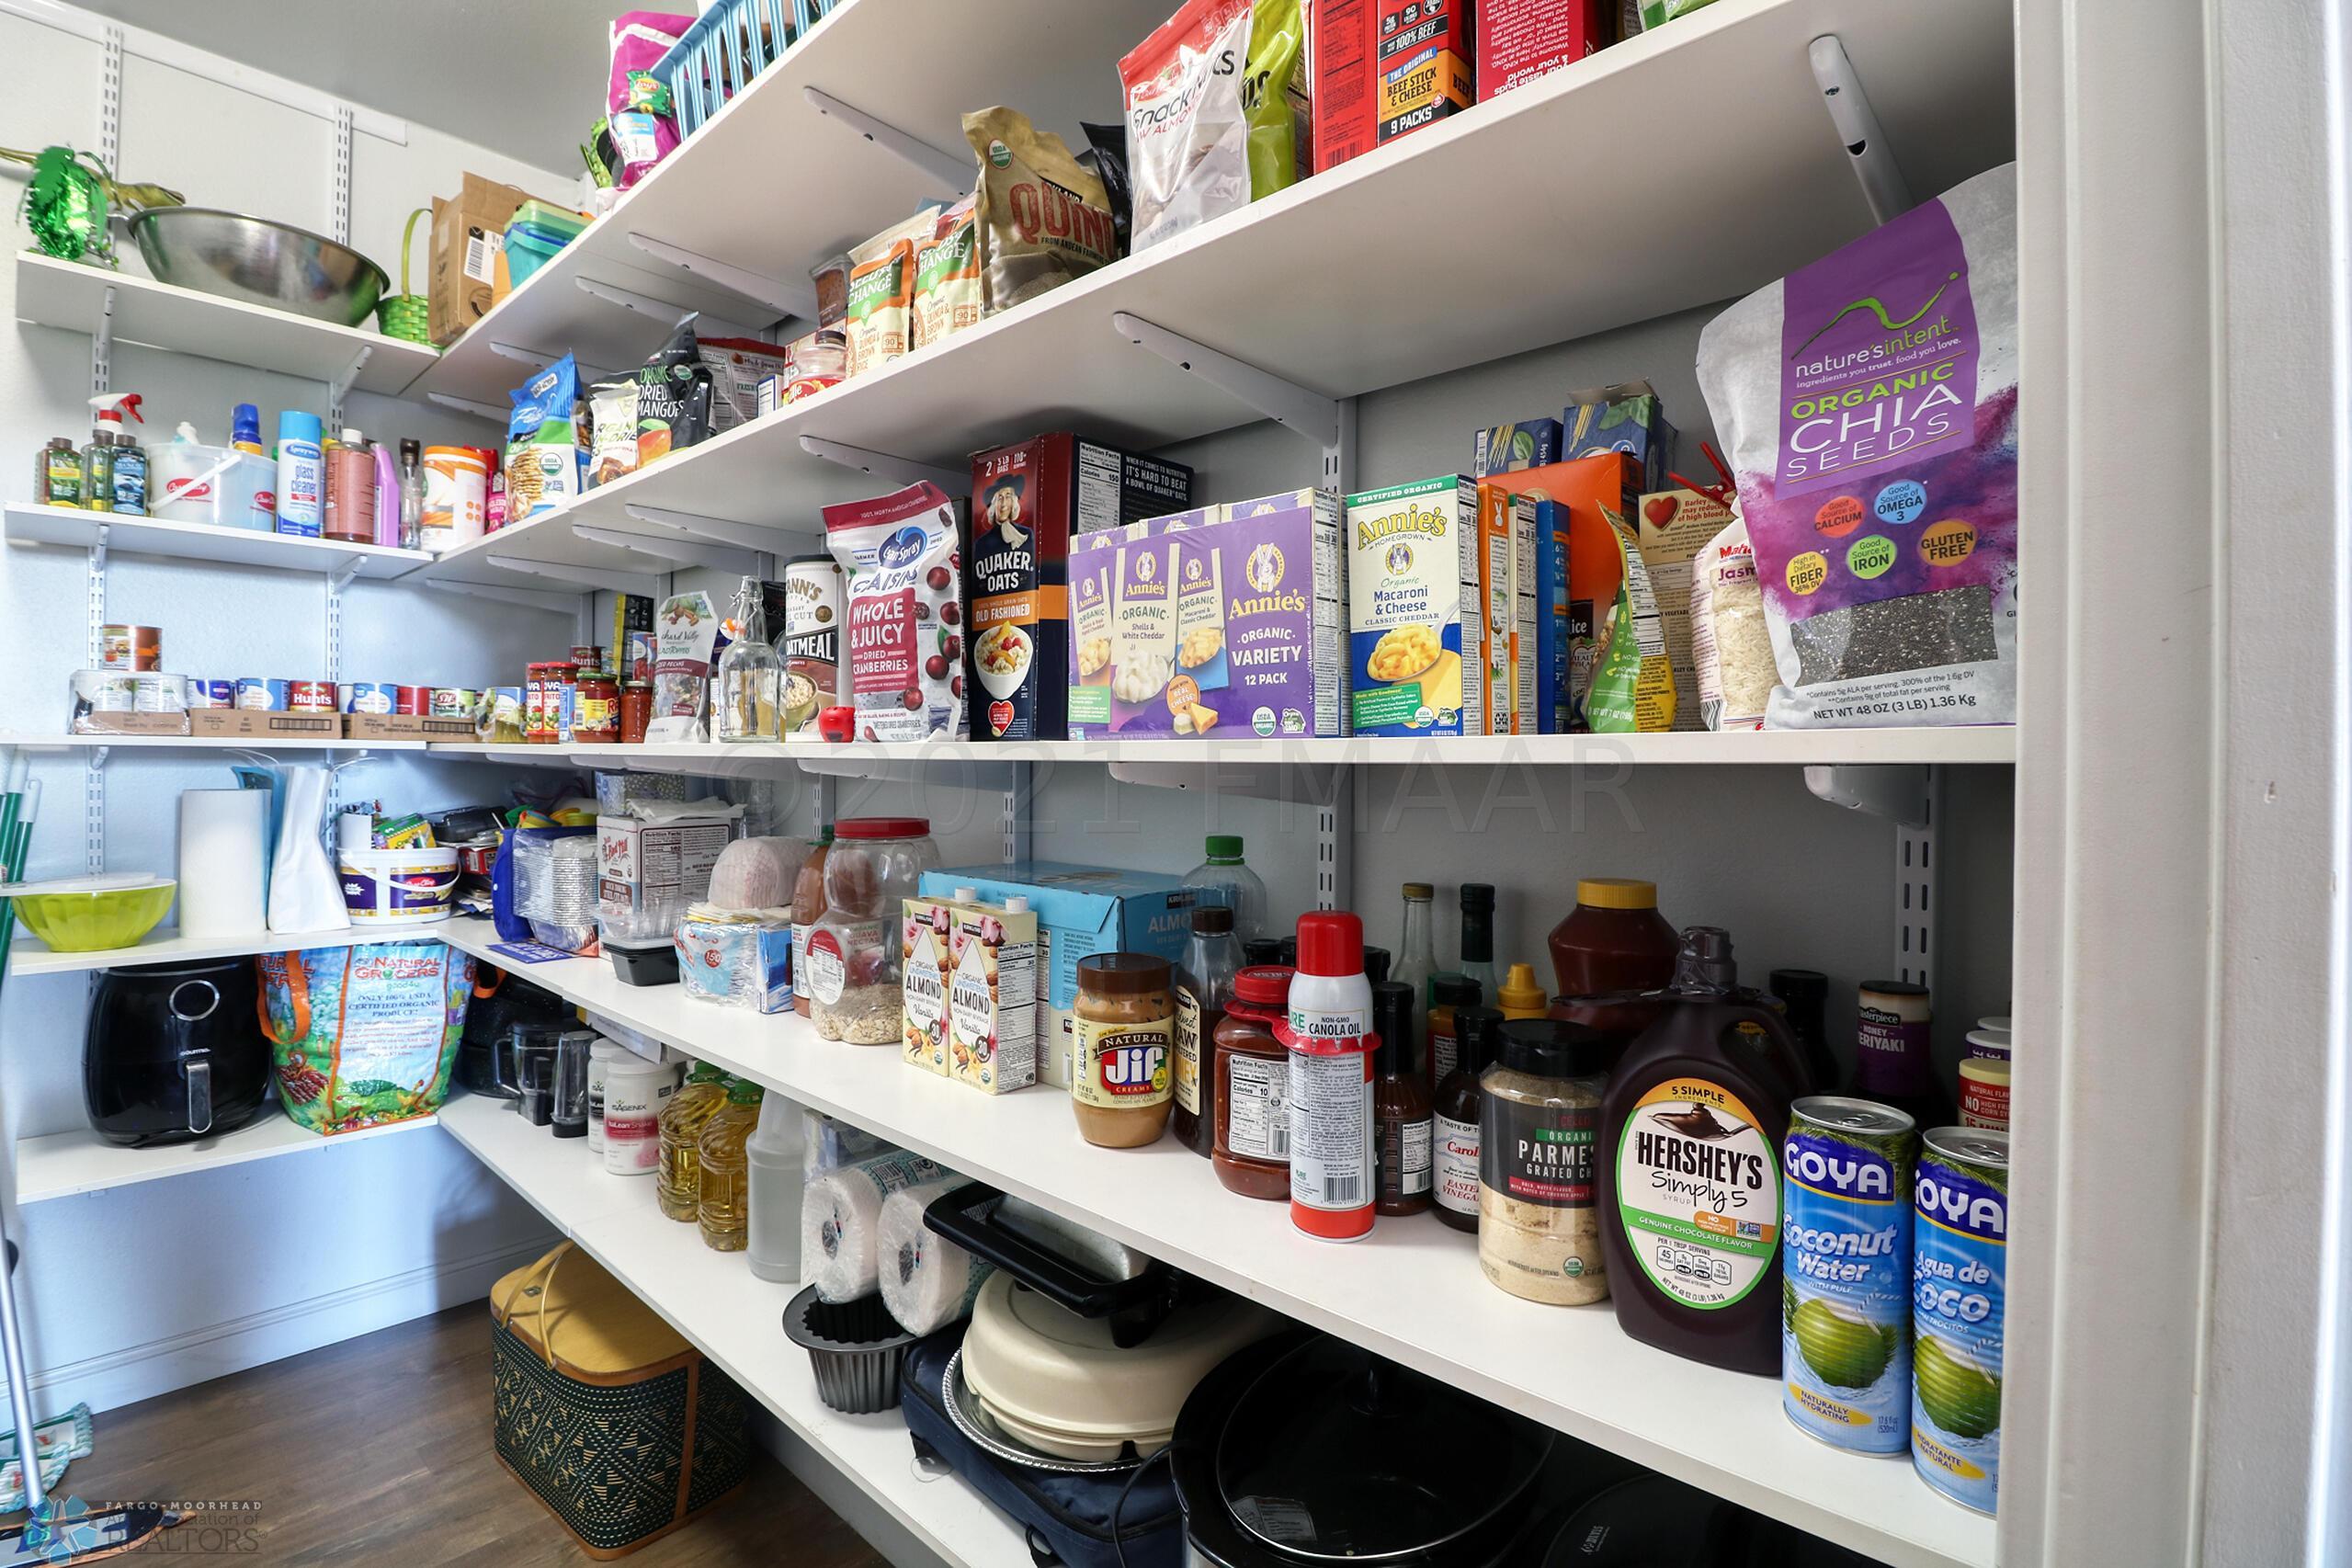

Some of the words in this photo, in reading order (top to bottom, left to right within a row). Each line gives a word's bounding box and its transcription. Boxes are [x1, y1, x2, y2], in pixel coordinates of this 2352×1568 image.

[1396, 28, 1416, 50] 100%
[1417, 21, 1437, 40] BEEF
[1539, 42, 1569, 56] Welcome
[1391, 69, 1403, 81] THE
[1403, 49, 1434, 74] ORIGINAL
[1536, 55, 1560, 69] your
[1387, 79, 1408, 97] BEEF
[1410, 66, 1437, 86] STICK
[1507, 65, 1535, 83] world
[1399, 81, 1433, 103] CHEESE
[1133, 88, 1189, 129] Snack
[1391, 119, 1398, 135] 9
[1400, 106, 1433, 132] PACKS
[1041, 236, 1060, 245] FROM
[848, 273, 892, 307] CHANGE
[1796, 371, 1847, 390] ingredients
[1849, 367, 1867, 381] you
[1895, 352, 1917, 365] food
[1918, 347, 1937, 360] you
[1937, 338, 1962, 351] love.
[1791, 362, 1955, 419] ORGANIC
[1790, 383, 1963, 454] CHIA
[1081, 444, 1105, 455] Nutrition
[1106, 450, 1119, 460] Facts
[1786, 413, 1949, 478] SEEDS
[295, 463, 314, 479] glass
[985, 461, 993, 477] 2
[1081, 468, 1100, 478] Calories
[1126, 465, 1140, 478] IT'S
[1141, 469, 1159, 483] HARD
[1161, 474, 1169, 486] TO
[1170, 478, 1187, 491] BEAT
[1131, 478, 1145, 490] BOWL
[290, 478, 317, 495] cleaner
[1358, 489, 1403, 504] CERTIFIED
[1403, 482, 1443, 495] ORGANIC
[1888, 483, 1910, 495] Good
[1877, 495, 1924, 515] OMEGA
[1880, 491, 1908, 505] Source
[1813, 511, 1862, 531] CALCIUM
[1896, 511, 1905, 521] 3
[1358, 503, 1448, 551] Annie's
[1374, 532, 1426, 549] HOMEGROWN
[1859, 539, 1881, 551] Good
[1921, 530, 1974, 551] GLUTEN
[900, 540, 922, 562] Spray
[1852, 547, 1880, 560] Source
[1929, 543, 1968, 561] FREE
[975, 551, 1030, 580] QUAKER
[1793, 562, 1817, 574] Dietary
[1854, 553, 1890, 572] IRON
[987, 572, 1019, 592] OATS
[1381, 576, 1420, 588] Organic
[1790, 567, 1824, 588] FIBER
[1124, 581, 1165, 597] Annie's
[1179, 577, 1212, 595] Annie's
[1374, 585, 1428, 602] Macaroni
[1078, 593, 1102, 609] Annie's
[1179, 596, 1215, 611] ORGANIC
[1228, 588, 1306, 621] Annie's
[1375, 604, 1384, 616] &
[1385, 600, 1427, 615] Cheese
[794, 611, 813, 620] CUT
[852, 597, 904, 625] WHOLE
[976, 610, 989, 623] OLD
[991, 603, 1030, 620] FASHIONED
[1121, 606, 1167, 621] ORGANIC
[1197, 613, 1216, 621] Cheddar
[1365, 617, 1397, 626] CLASSIC
[1399, 612, 1440, 623] CHEDDAR
[851, 629, 860, 647] &
[859, 623, 905, 647] JUICY
[1141, 631, 1165, 640] Cheddar
[1241, 627, 1292, 644] ORGANIC
[863, 650, 886, 660] DRIED
[1232, 645, 1302, 667] VARIETY
[853, 659, 908, 675] CRANBERRIES
[1244, 676, 1256, 686] 12
[1258, 672, 1288, 685] PACK
[1924, 684, 1950, 694] serving
[1813, 710, 1834, 720] NET
[1835, 707, 1853, 718] WT
[1857, 704, 1871, 714] 48
[1874, 702, 1890, 713] OZ
[1892, 701, 1905, 713] (3
[1908, 699, 1928, 710] LB)
[1930, 696, 1956, 708] 1.36
[1959, 694, 1976, 706] Kg
[374, 956, 441, 967] NATURAL
[706, 951, 722, 962] 150
[915, 960, 934, 971] ORGANIC
[355, 968, 439, 980] GROCERS
[961, 971, 983, 984] ORGANIC
[905, 973, 942, 1000] ALMOND
[399, 1000, 440, 1009] ORGANIC
[952, 988, 991, 1016] ALMOND
[913, 1003, 934, 1018] Vanilla
[1858, 1009, 1899, 1026] asterpiece
[960, 1017, 981, 1033] Vanilla
[1309, 1023, 1347, 1036] CANOLA
[1347, 1022, 1361, 1034] OIL
[1863, 1025, 1887, 1037] HONEY
[1105, 1034, 1164, 1047] NATURAL
[1858, 1037, 1904, 1052] ERIYAKI
[1105, 1047, 1164, 1085] Jif
[1233, 1059, 1253, 1067] Nutrition
[1233, 1084, 1254, 1095] Calories
[1672, 1085, 1678, 1096] 5
[1681, 1085, 1725, 1104] SIMPLE
[1970, 1085, 1994, 1097] NATURAL
[1674, 1095, 1722, 1108] INGREDIENTS
[1965, 1096, 1980, 1111] NO
[1981, 1101, 1995, 1109] HIGH
[1444, 1120, 1460, 1131] TASTE
[1549, 1131, 1592, 1142] ORGANI
[1638, 1131, 1763, 1190] HERSHEY'S
[1786, 1142, 1888, 1194] GOYA
[1526, 1163, 1572, 1178] GRATED
[1442, 1187, 1479, 1202] VINEGA
[1652, 1171, 1728, 1213] Simply
[1731, 1190, 1747, 1208] 5
[1662, 1194, 1691, 1206] SYRUP
[1639, 1216, 1673, 1232] GENUINE
[1675, 1225, 1720, 1243] CHOCOLATE
[1721, 1237, 1754, 1249] FLAVOR
[1783, 1212, 1898, 1257] Coconut
[1661, 1249, 1671, 1259] 45
[1688, 1244, 1710, 1256] SERVING
[1797, 1252, 1870, 1283] Water
[1917, 1250, 1954, 1280] Agua
[1958, 1260, 1990, 1285] de
[1831, 1283, 1853, 1294] PULP
[1801, 1390, 1849, 1415] NATURALLY
[1801, 1397, 1850, 1424] HYDRATING
[1917, 1431, 1961, 1468] HIDRATANTE
[1920, 1443, 1954, 1471] NATURAL
